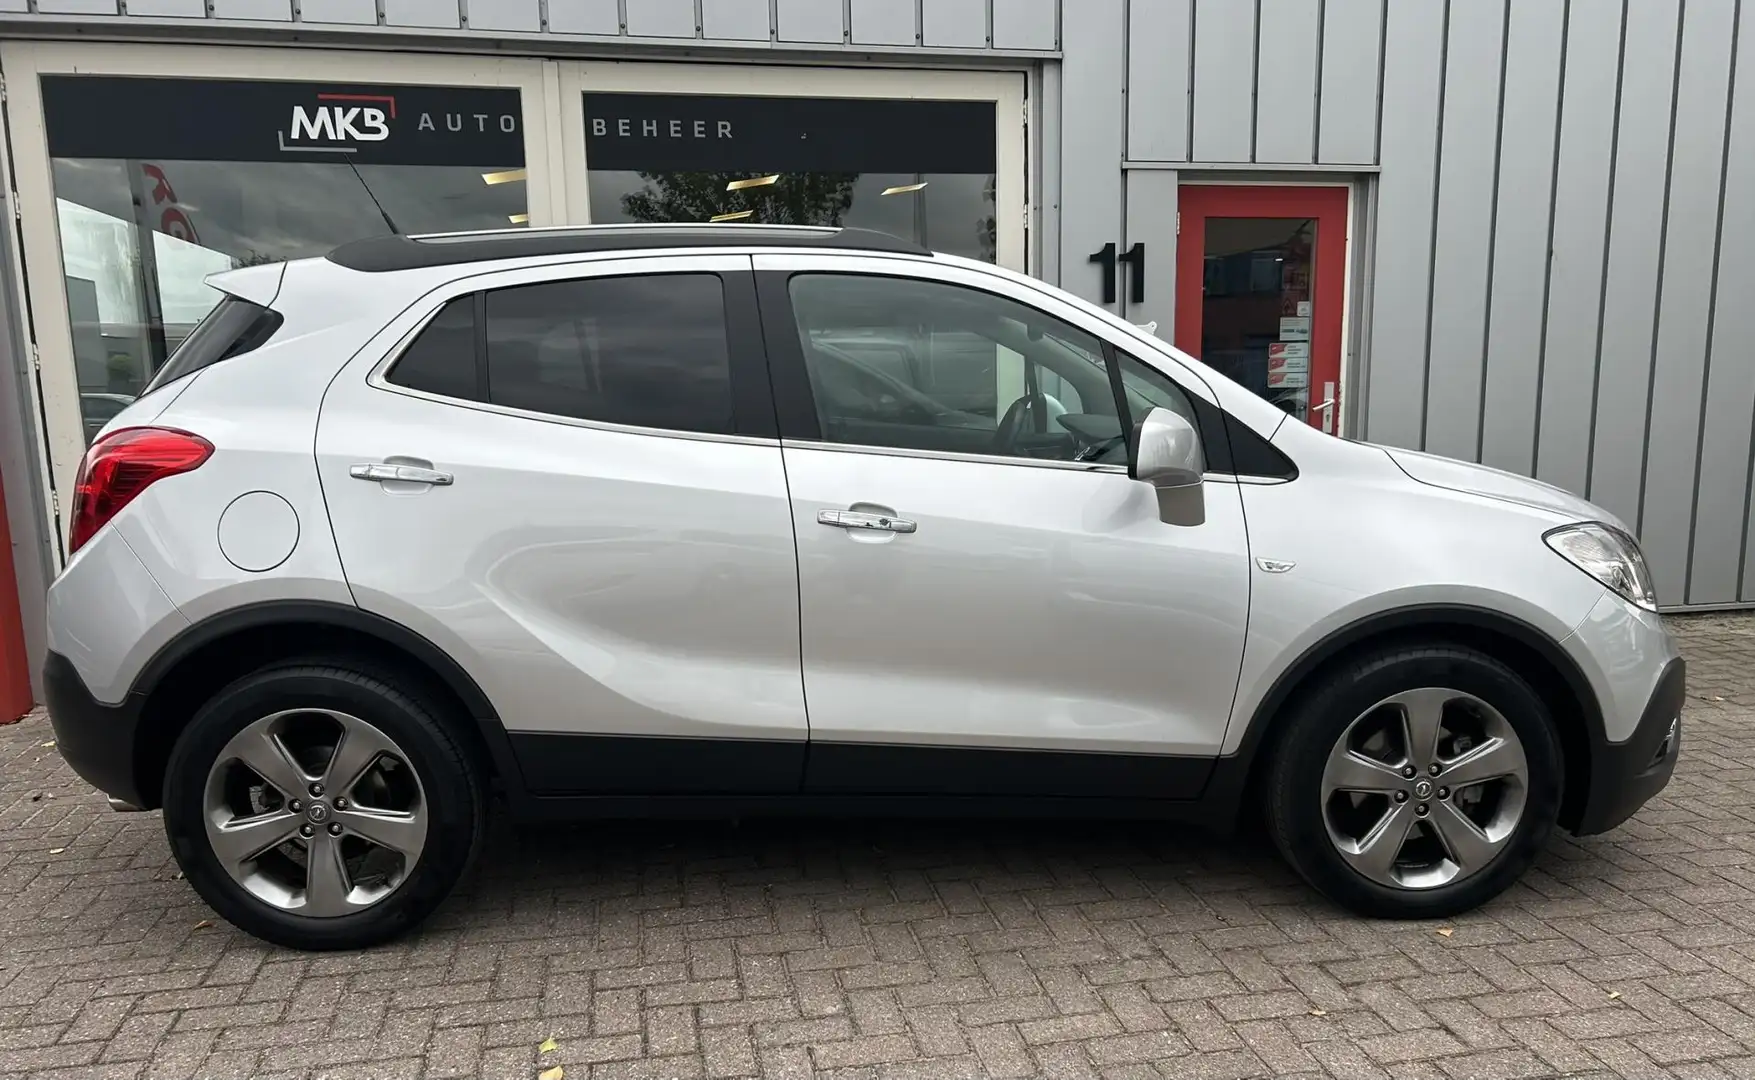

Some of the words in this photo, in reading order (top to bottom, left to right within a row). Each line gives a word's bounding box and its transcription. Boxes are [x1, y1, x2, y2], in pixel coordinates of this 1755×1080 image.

[290, 105, 390, 142] MKB
[417, 112, 515, 133] AUTO
[592, 117, 733, 139] BEHEER
[1089, 242, 1145, 303] 11
